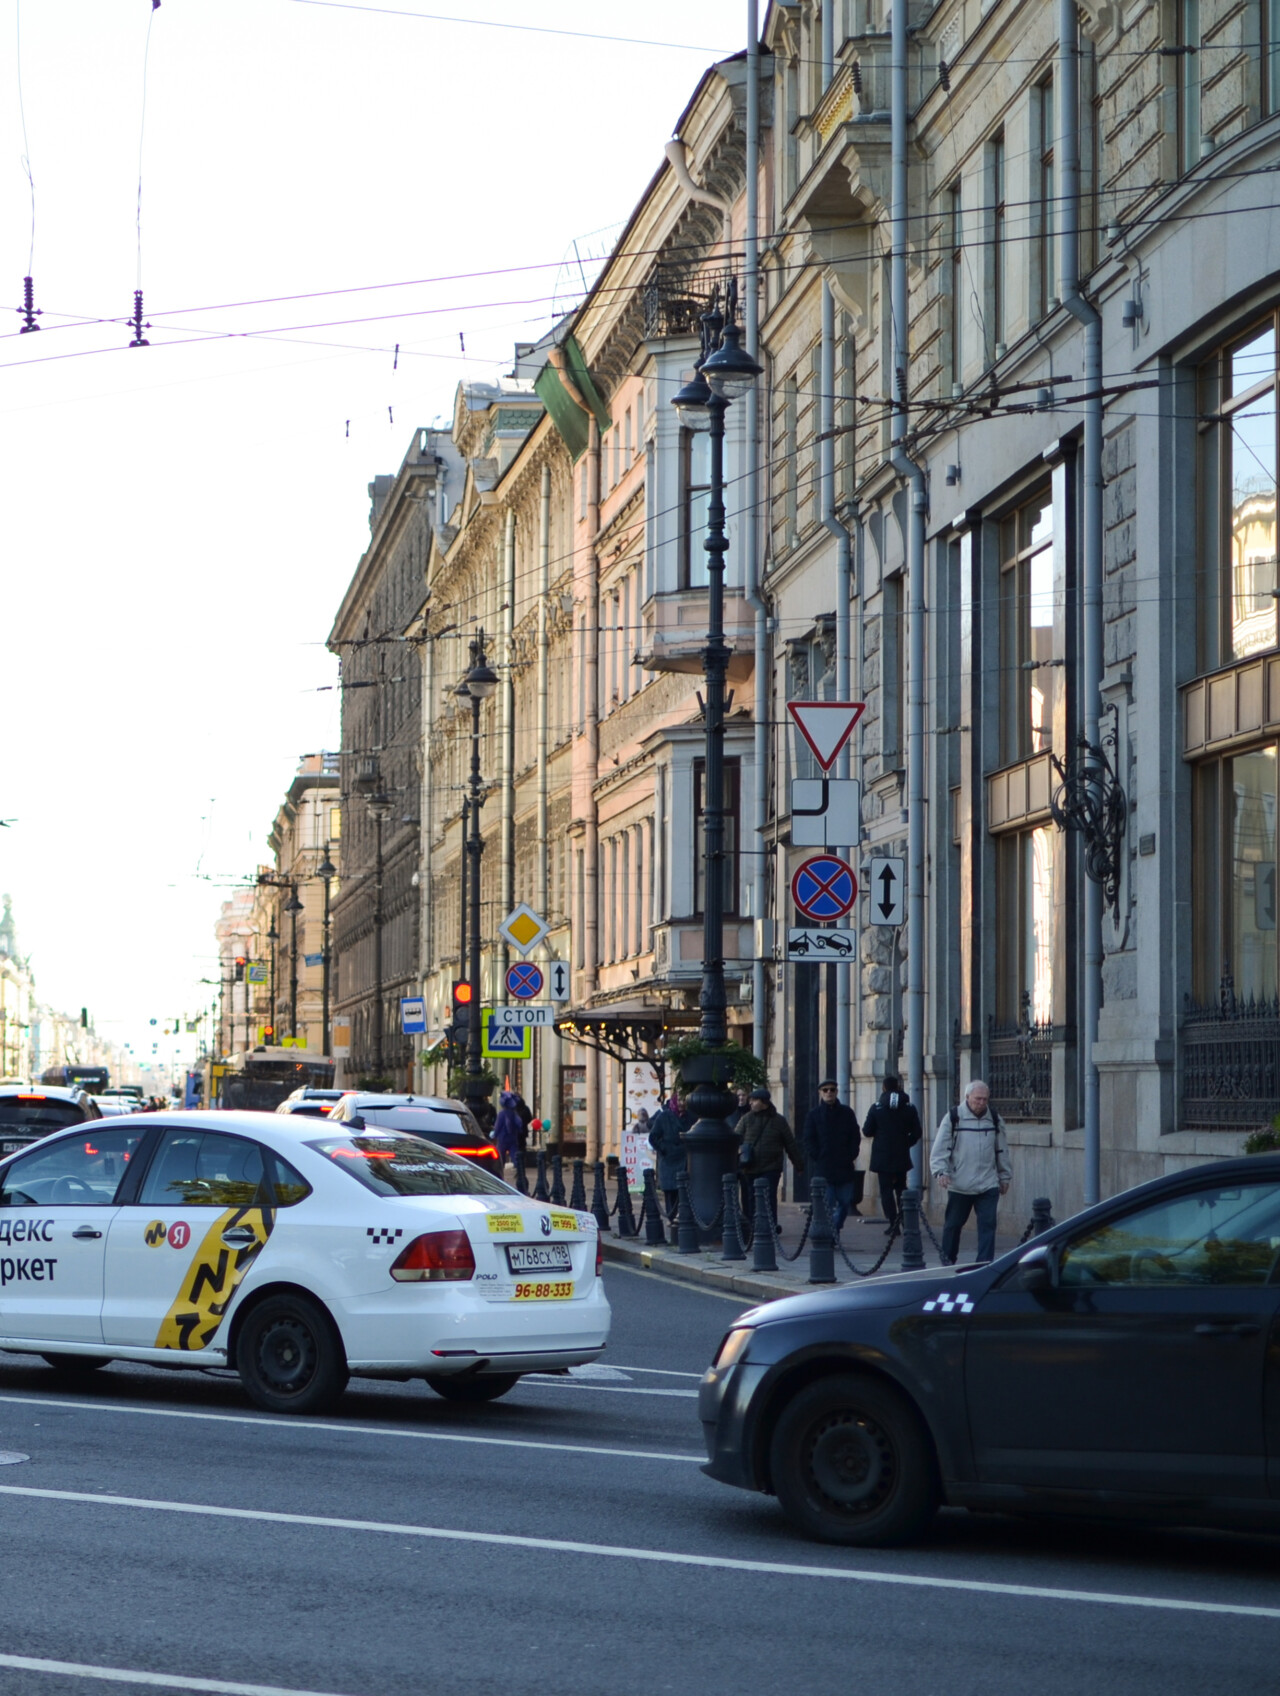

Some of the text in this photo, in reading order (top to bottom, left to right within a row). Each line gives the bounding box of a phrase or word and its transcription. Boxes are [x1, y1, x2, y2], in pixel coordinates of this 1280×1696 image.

[503, 1010, 545, 1023] СТОП
[560, 1219, 572, 1229] 999
[515, 1282, 572, 1298] 96-88-333
